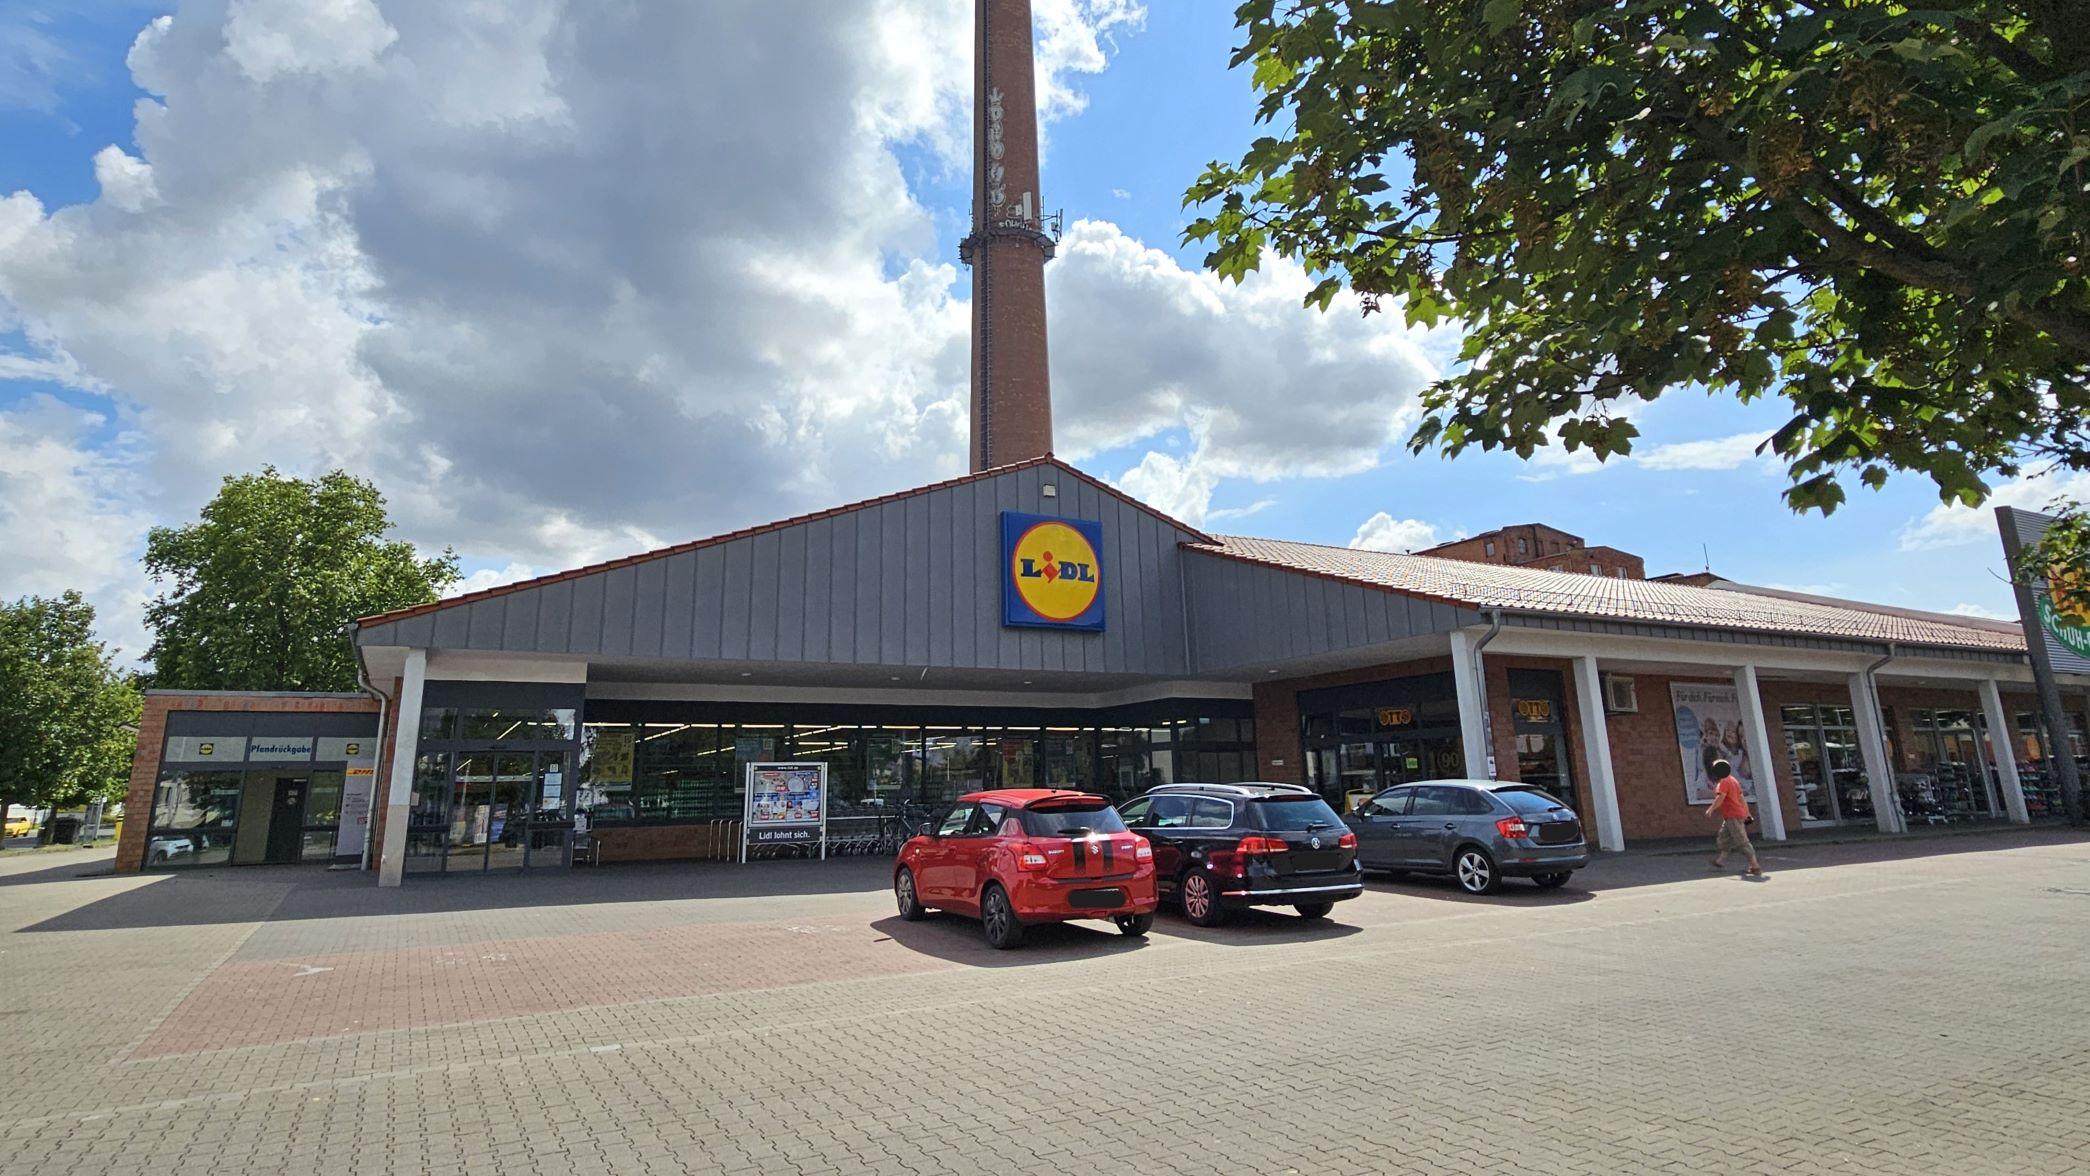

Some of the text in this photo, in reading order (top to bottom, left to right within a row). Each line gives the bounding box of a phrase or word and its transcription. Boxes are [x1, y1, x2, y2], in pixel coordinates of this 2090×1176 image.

[250, 744, 312, 755] Pfandrückgabe
[758, 830, 811, 840] Lidl lohnt sich.
